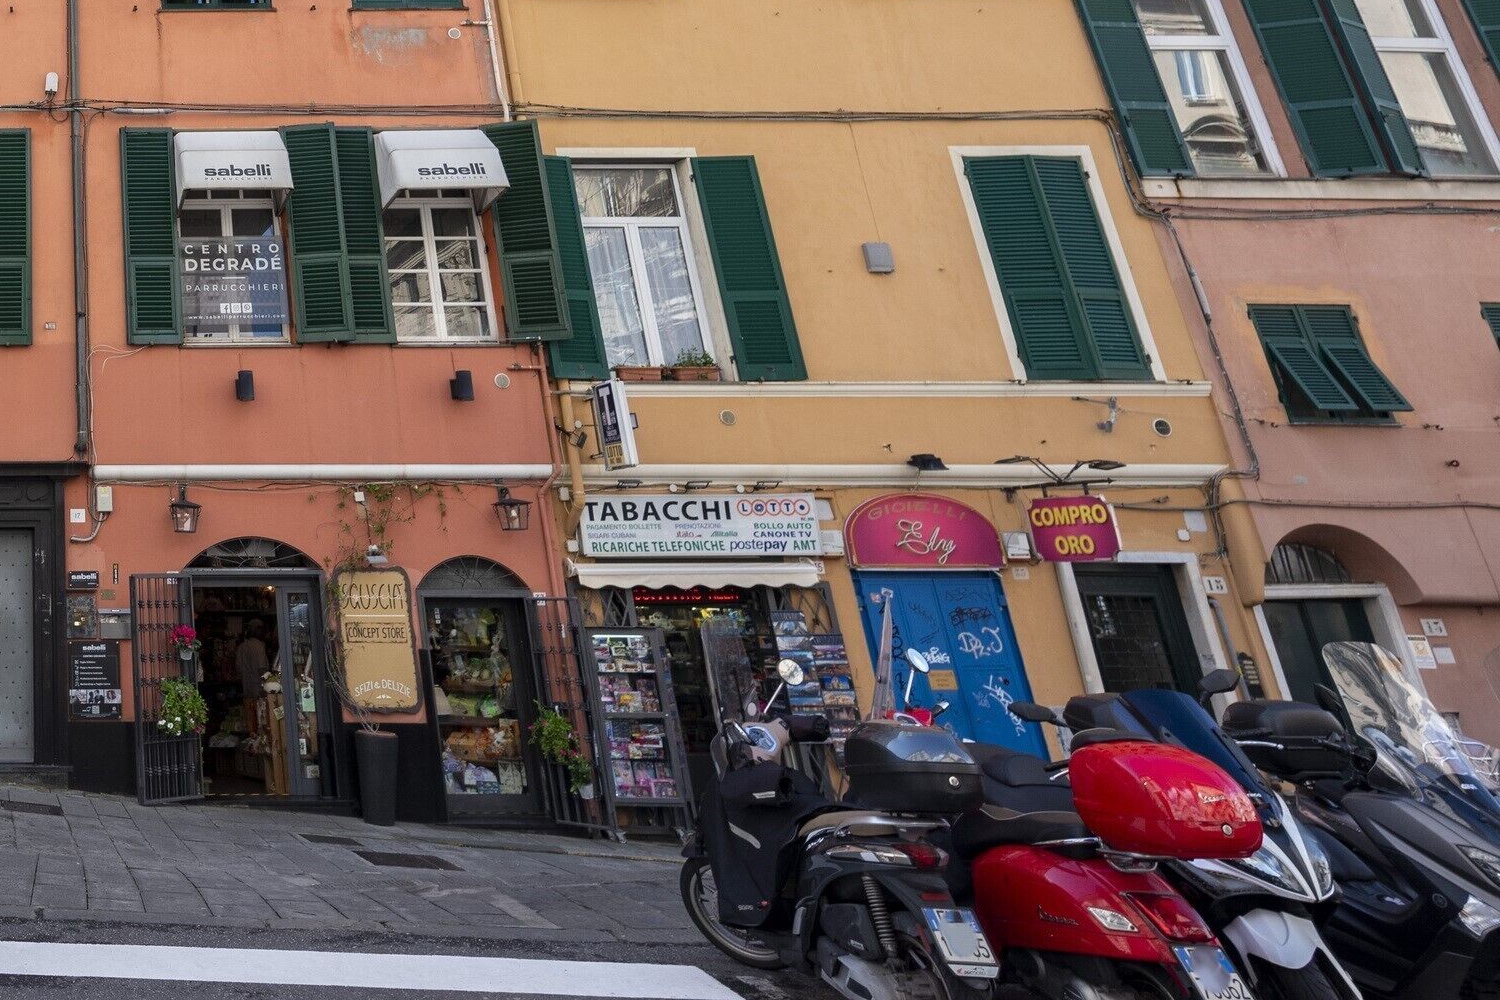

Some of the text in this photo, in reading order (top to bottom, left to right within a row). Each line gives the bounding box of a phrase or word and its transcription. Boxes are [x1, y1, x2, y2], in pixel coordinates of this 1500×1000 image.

[204, 164, 271, 176] sabelli
[417, 162, 486, 176] sabelli
[184, 243, 280, 255] CENTRO
[184, 254, 282, 272] DEGRADÉ
[186, 283, 284, 292] PARRUCCHIERI
[585, 500, 732, 521] TABACCHI
[1031, 503, 1108, 527] COMPRO
[753, 522, 812, 530] BOLLO AUTO
[753, 530, 812, 538] CANONE TV
[592, 539, 817, 553] RICARICHE TELEFONICHE postepay AMT
[1054, 534, 1095, 555] ORO
[348, 626, 406, 639] CONCEPT STORE
[354, 681, 374, 697] SFIZI
[381, 678, 412, 698] DELIZIE
